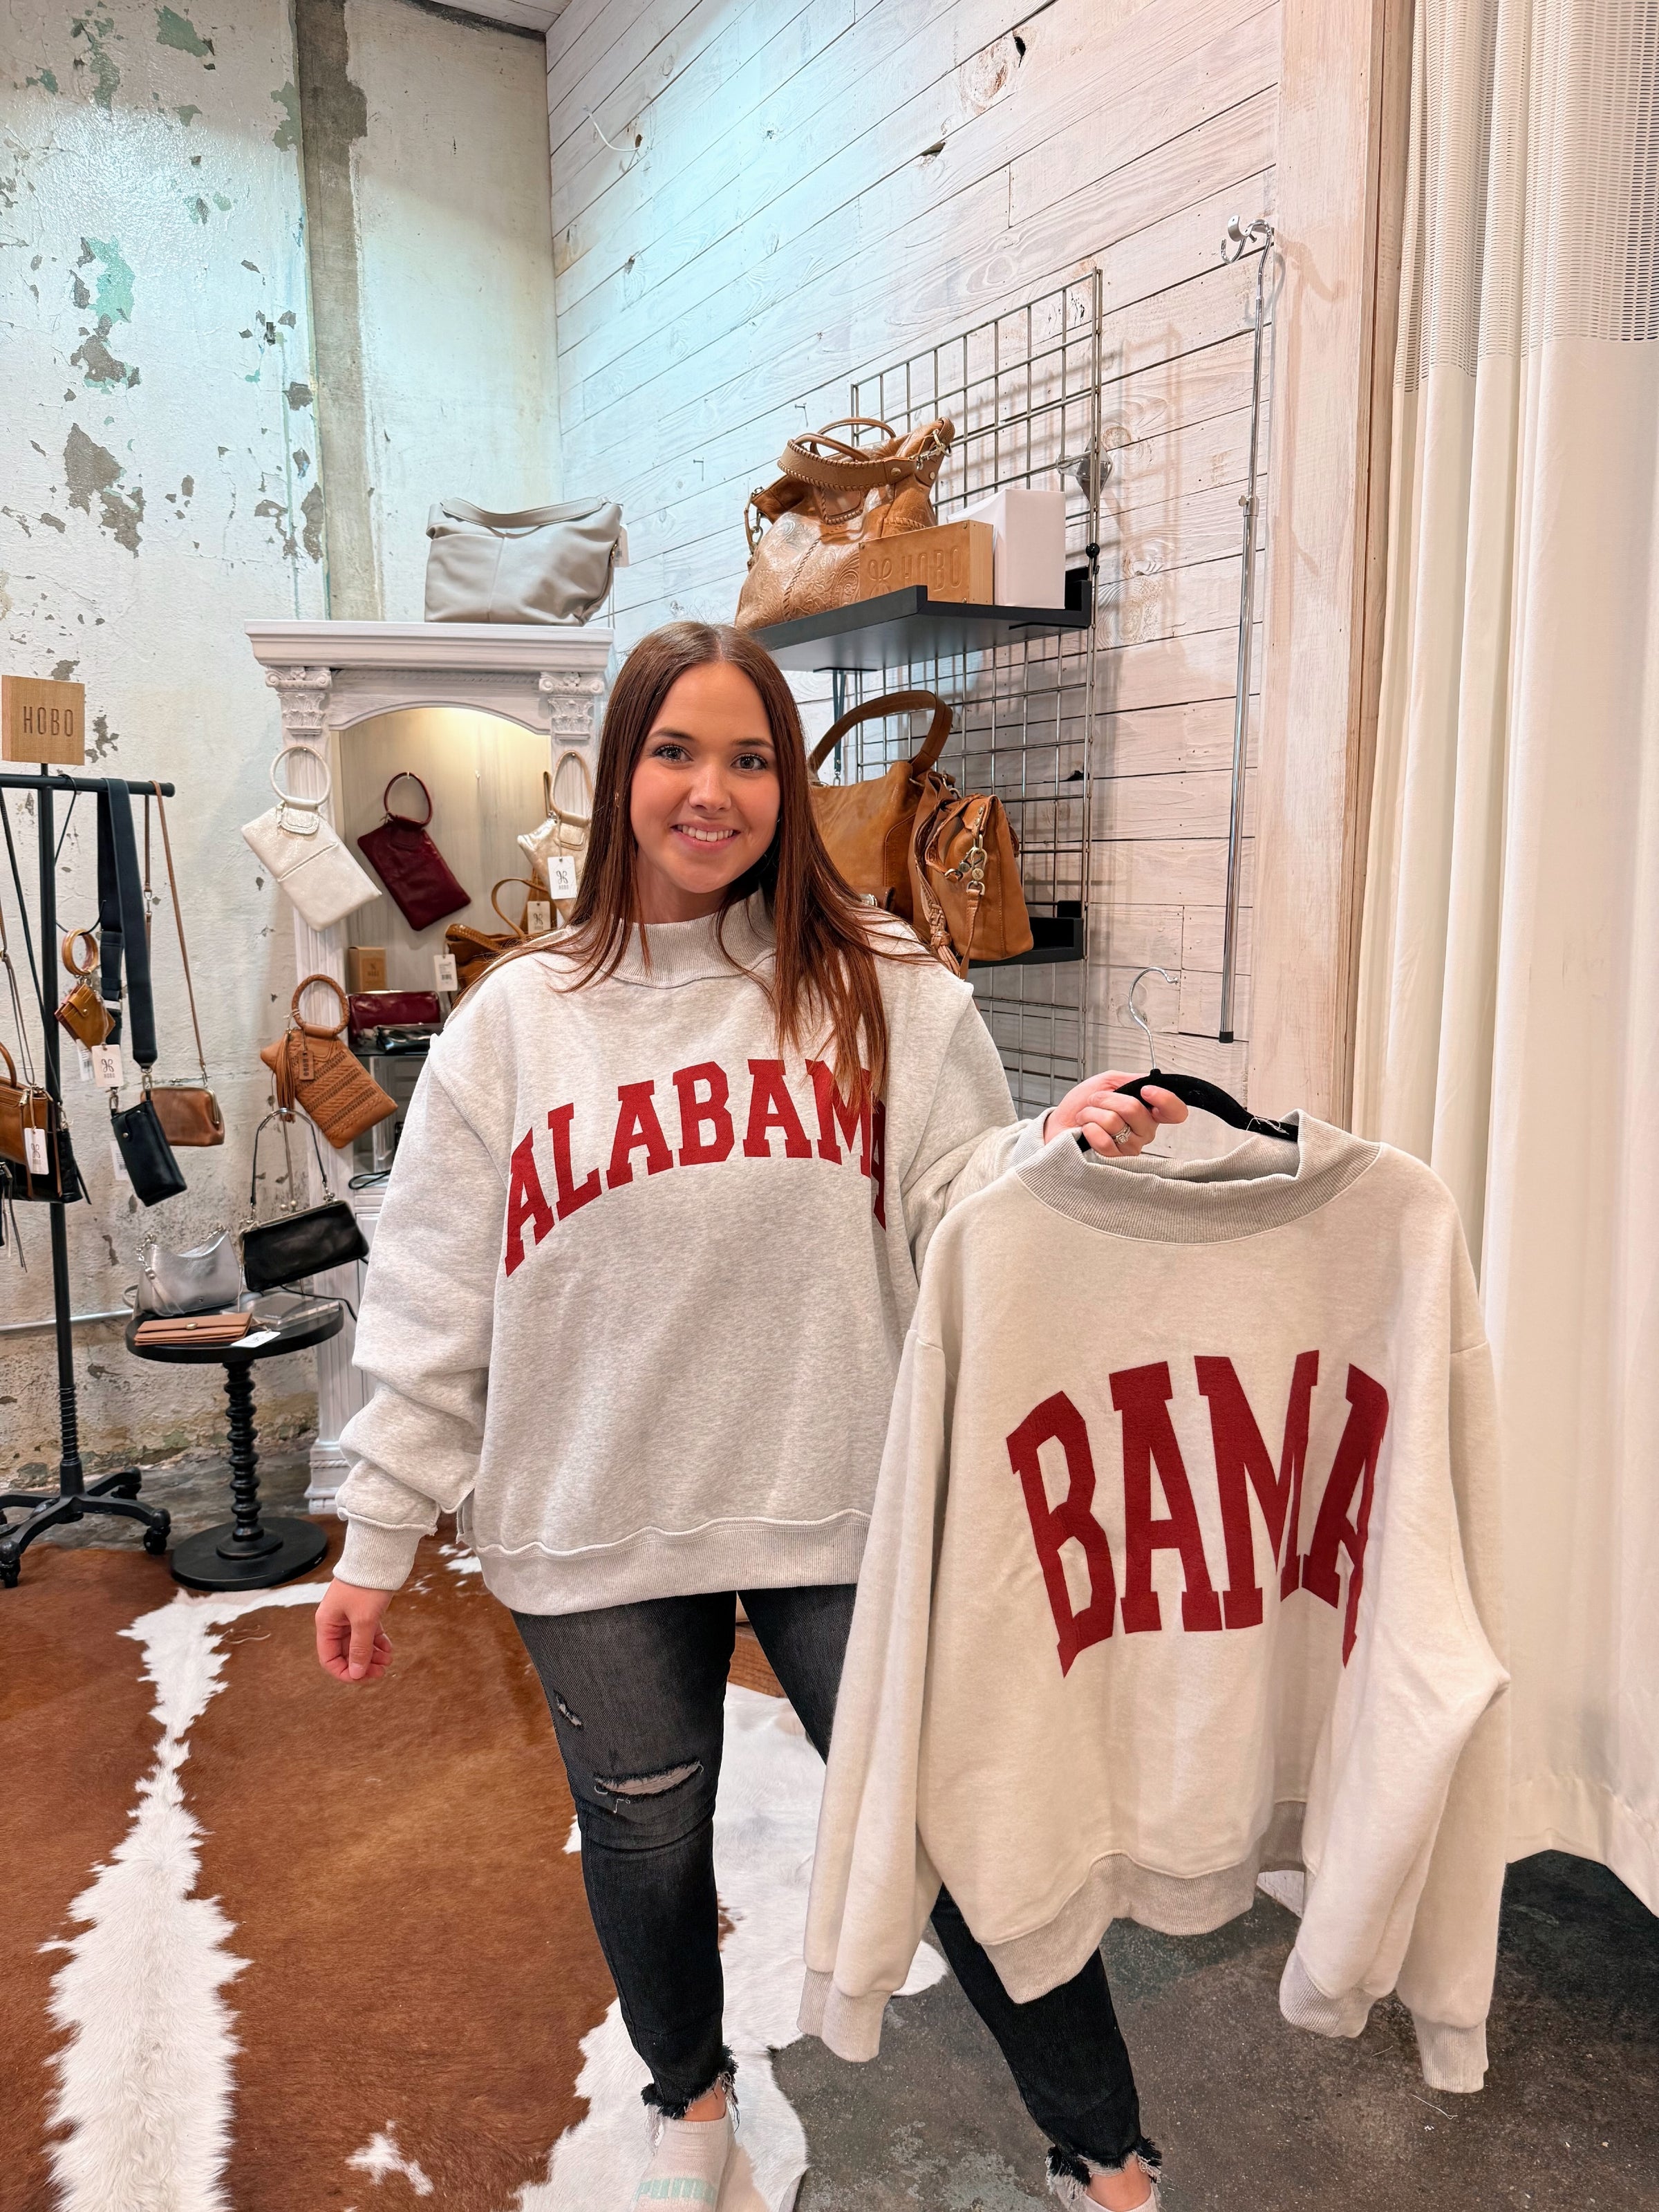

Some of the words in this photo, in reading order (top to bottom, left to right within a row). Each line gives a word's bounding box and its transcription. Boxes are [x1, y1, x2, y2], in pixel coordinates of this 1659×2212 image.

[901, 546, 962, 592] HOBO
[24, 706, 73, 737] HOBO
[505, 1058, 887, 1277] ALABAMA
[1006, 1349, 1389, 1678] BAMA
